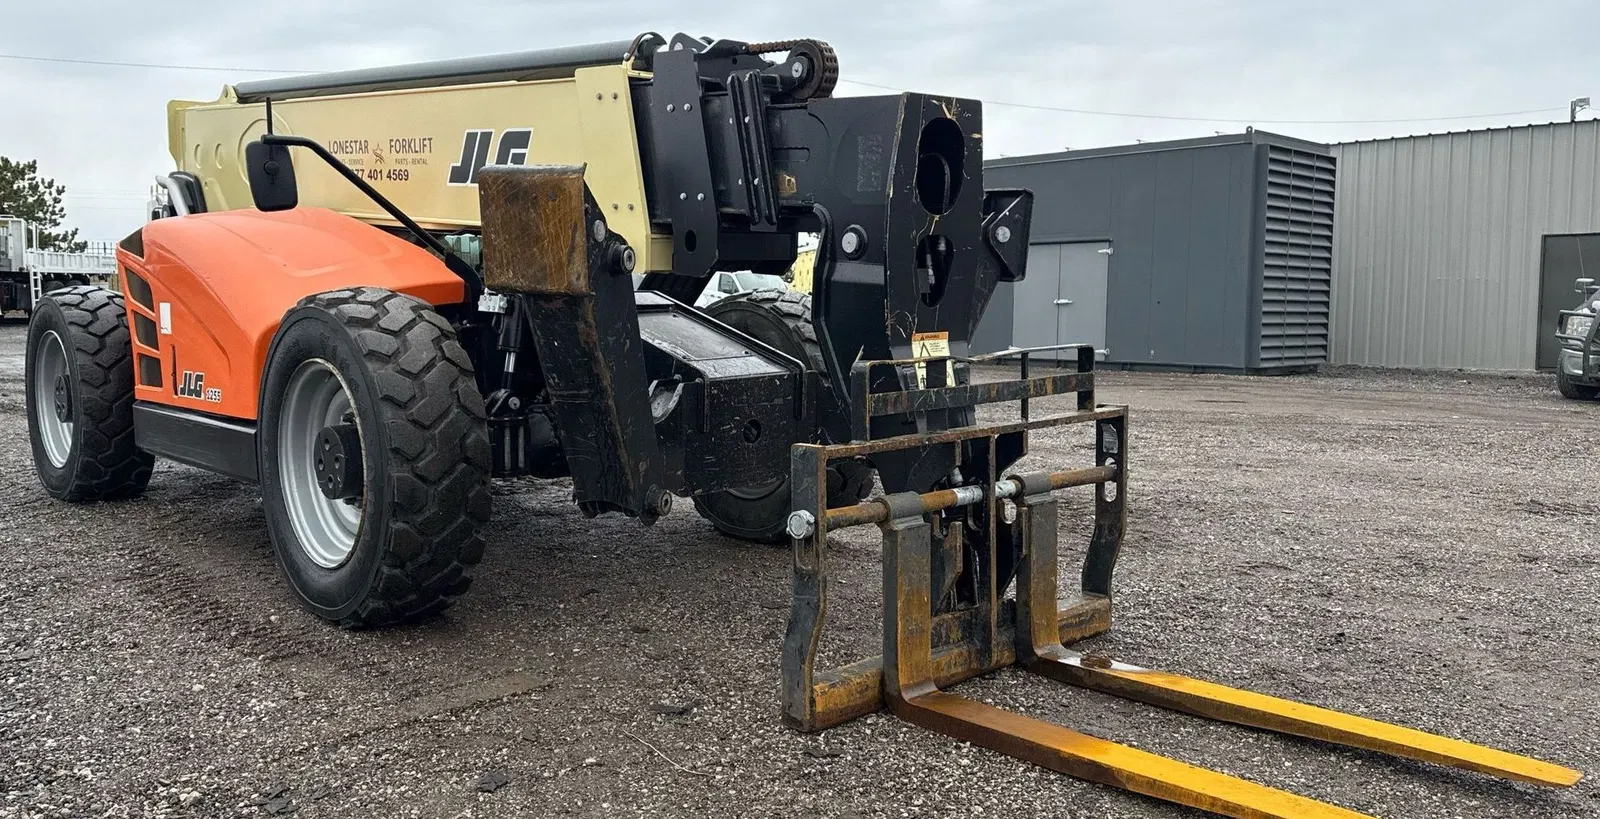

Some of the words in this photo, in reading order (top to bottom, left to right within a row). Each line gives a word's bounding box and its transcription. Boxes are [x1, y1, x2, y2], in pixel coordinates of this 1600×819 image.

[328, 139, 369, 155] LONESTAR
[389, 138, 433, 154] FORKLIFT
[447, 128, 533, 186] JLG
[351, 169, 365, 180] 77
[367, 169, 383, 181] 401
[386, 168, 409, 181] 4569
[179, 371, 204, 400] JLG
